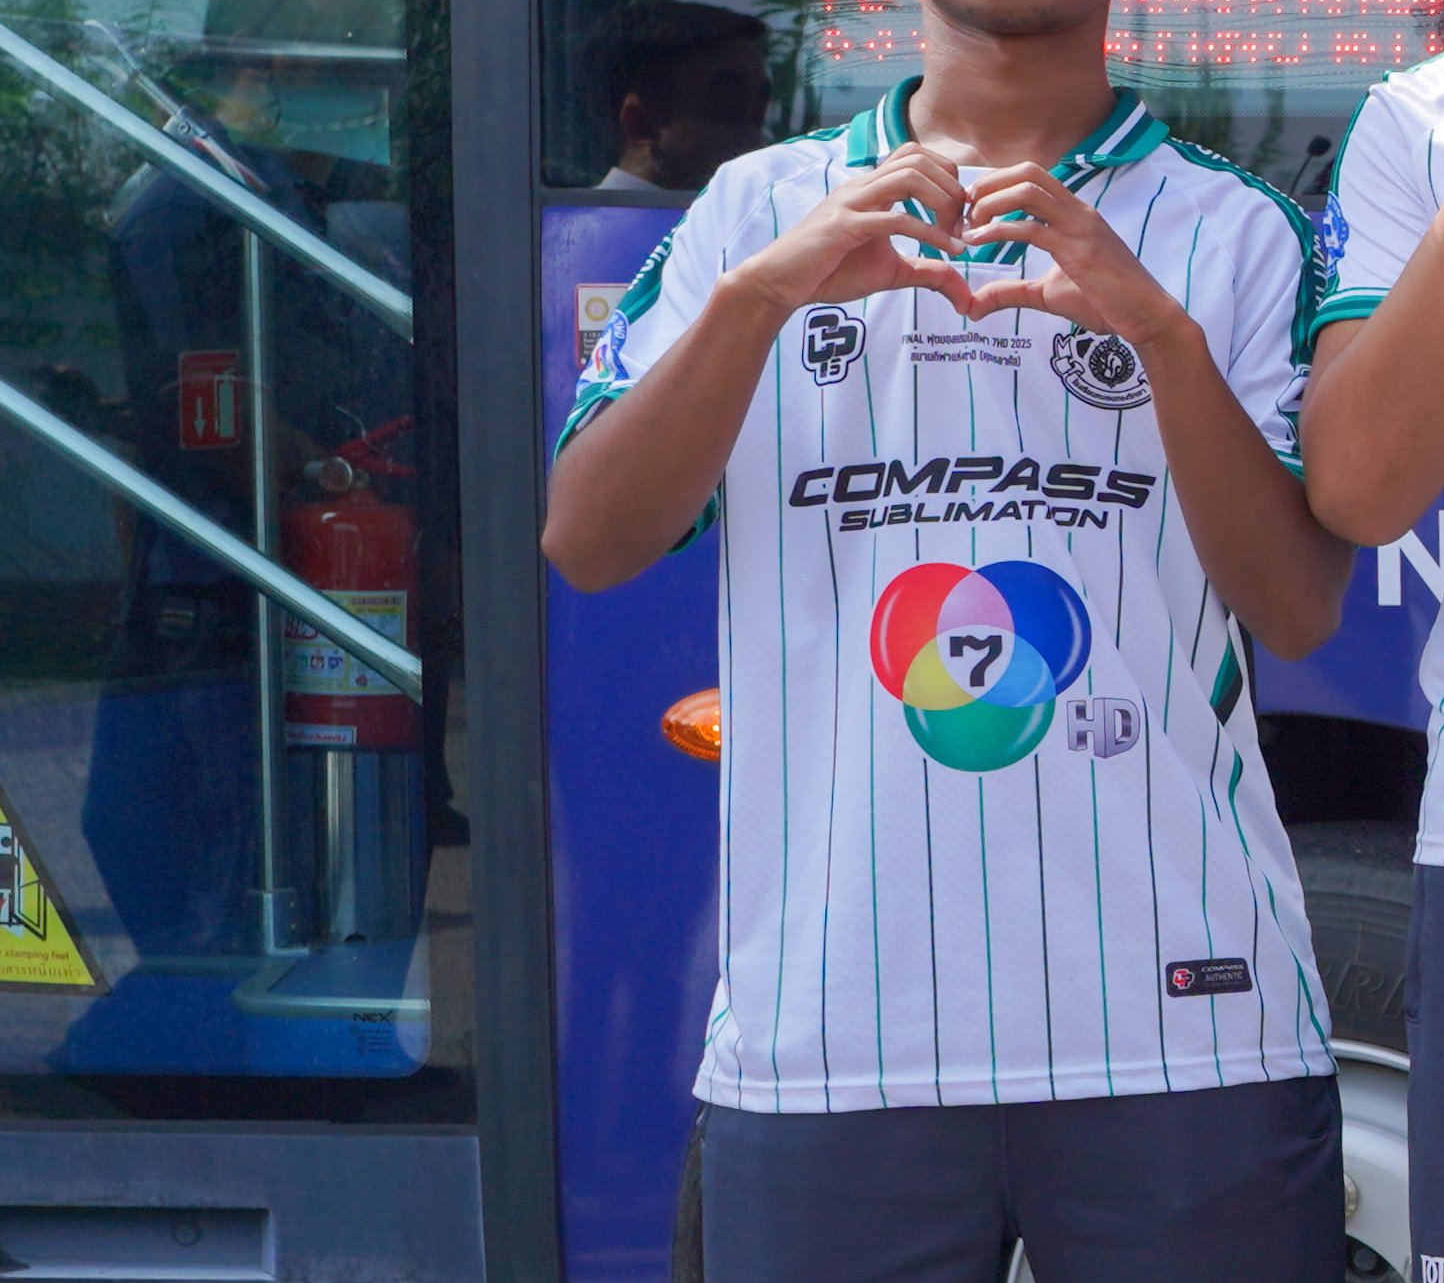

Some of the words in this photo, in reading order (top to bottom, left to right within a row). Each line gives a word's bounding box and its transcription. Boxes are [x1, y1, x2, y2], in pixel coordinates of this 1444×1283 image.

[901, 333, 924, 345] FINAL
[992, 336, 1009, 348] 7HD
[1011, 336, 1033, 349] 2025
[788, 456, 1158, 510] COMPASS
[837, 500, 1110, 533] SUBLIMATION
[948, 633, 1004, 688] 7
[1066, 695, 1141, 761] HD
